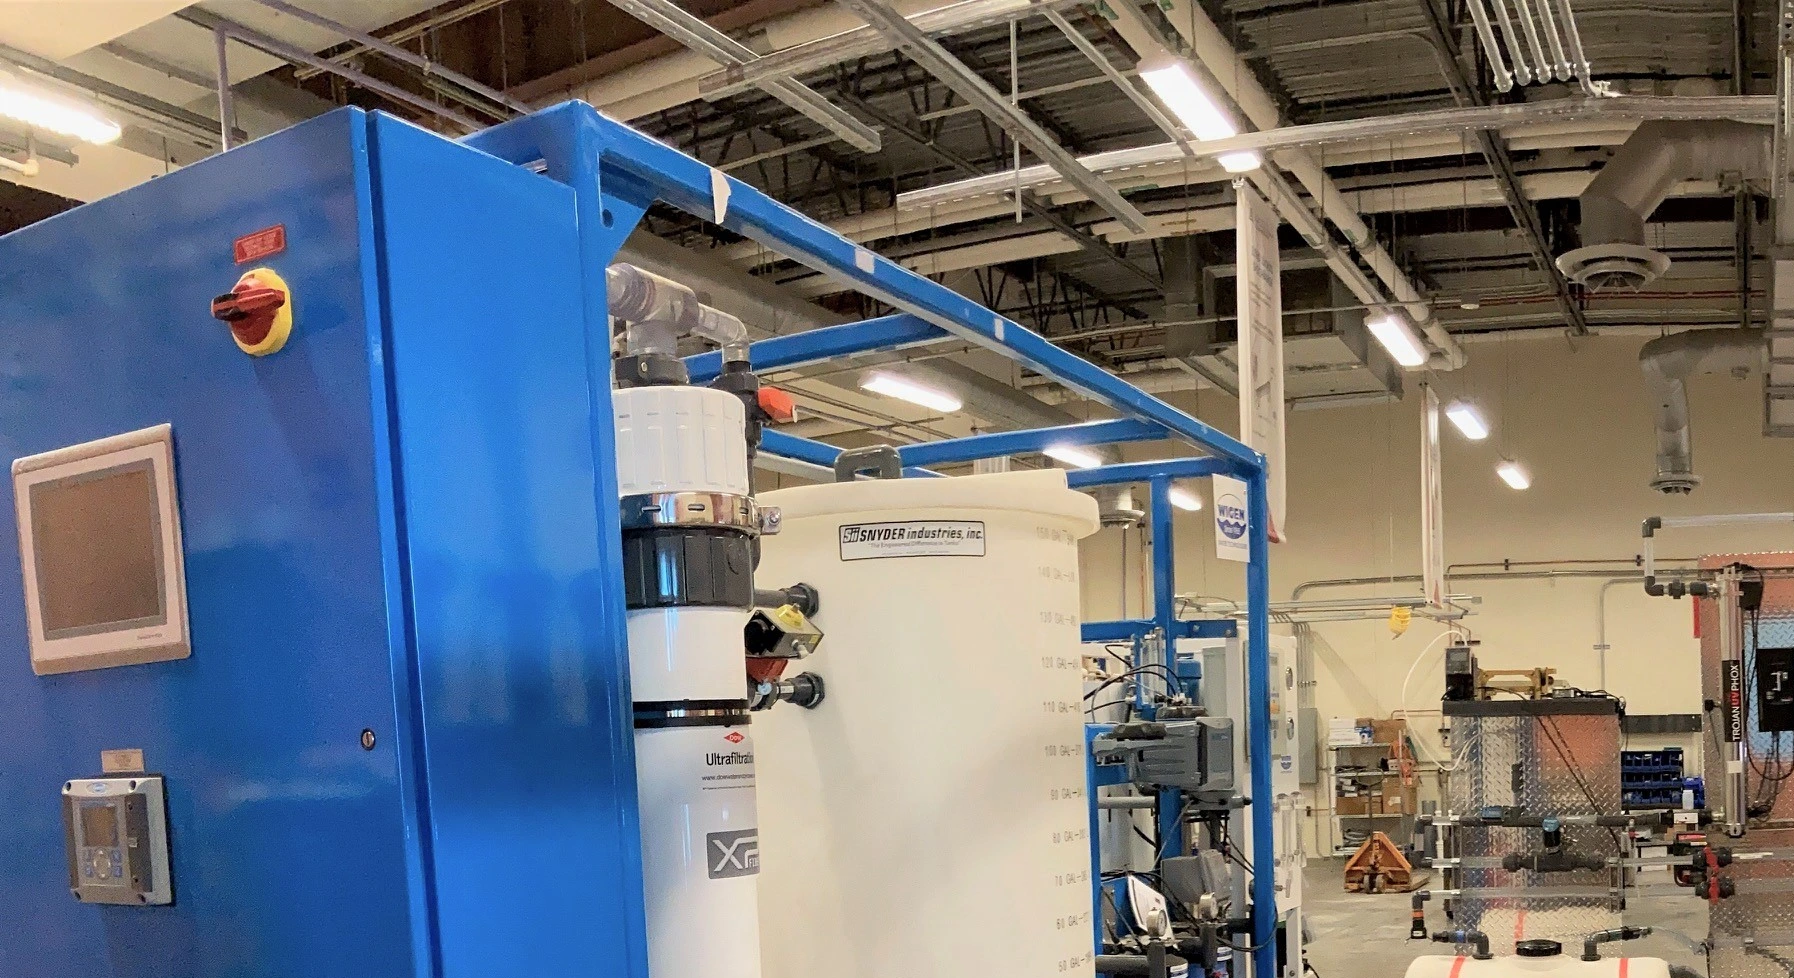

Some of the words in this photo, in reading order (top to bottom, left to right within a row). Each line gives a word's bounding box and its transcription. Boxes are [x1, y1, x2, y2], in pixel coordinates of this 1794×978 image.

[1218, 504, 1245, 521] WIGEN
[860, 528, 905, 542] SNYDER
[906, 526, 964, 540] industries,
[966, 527, 983, 539] inc.
